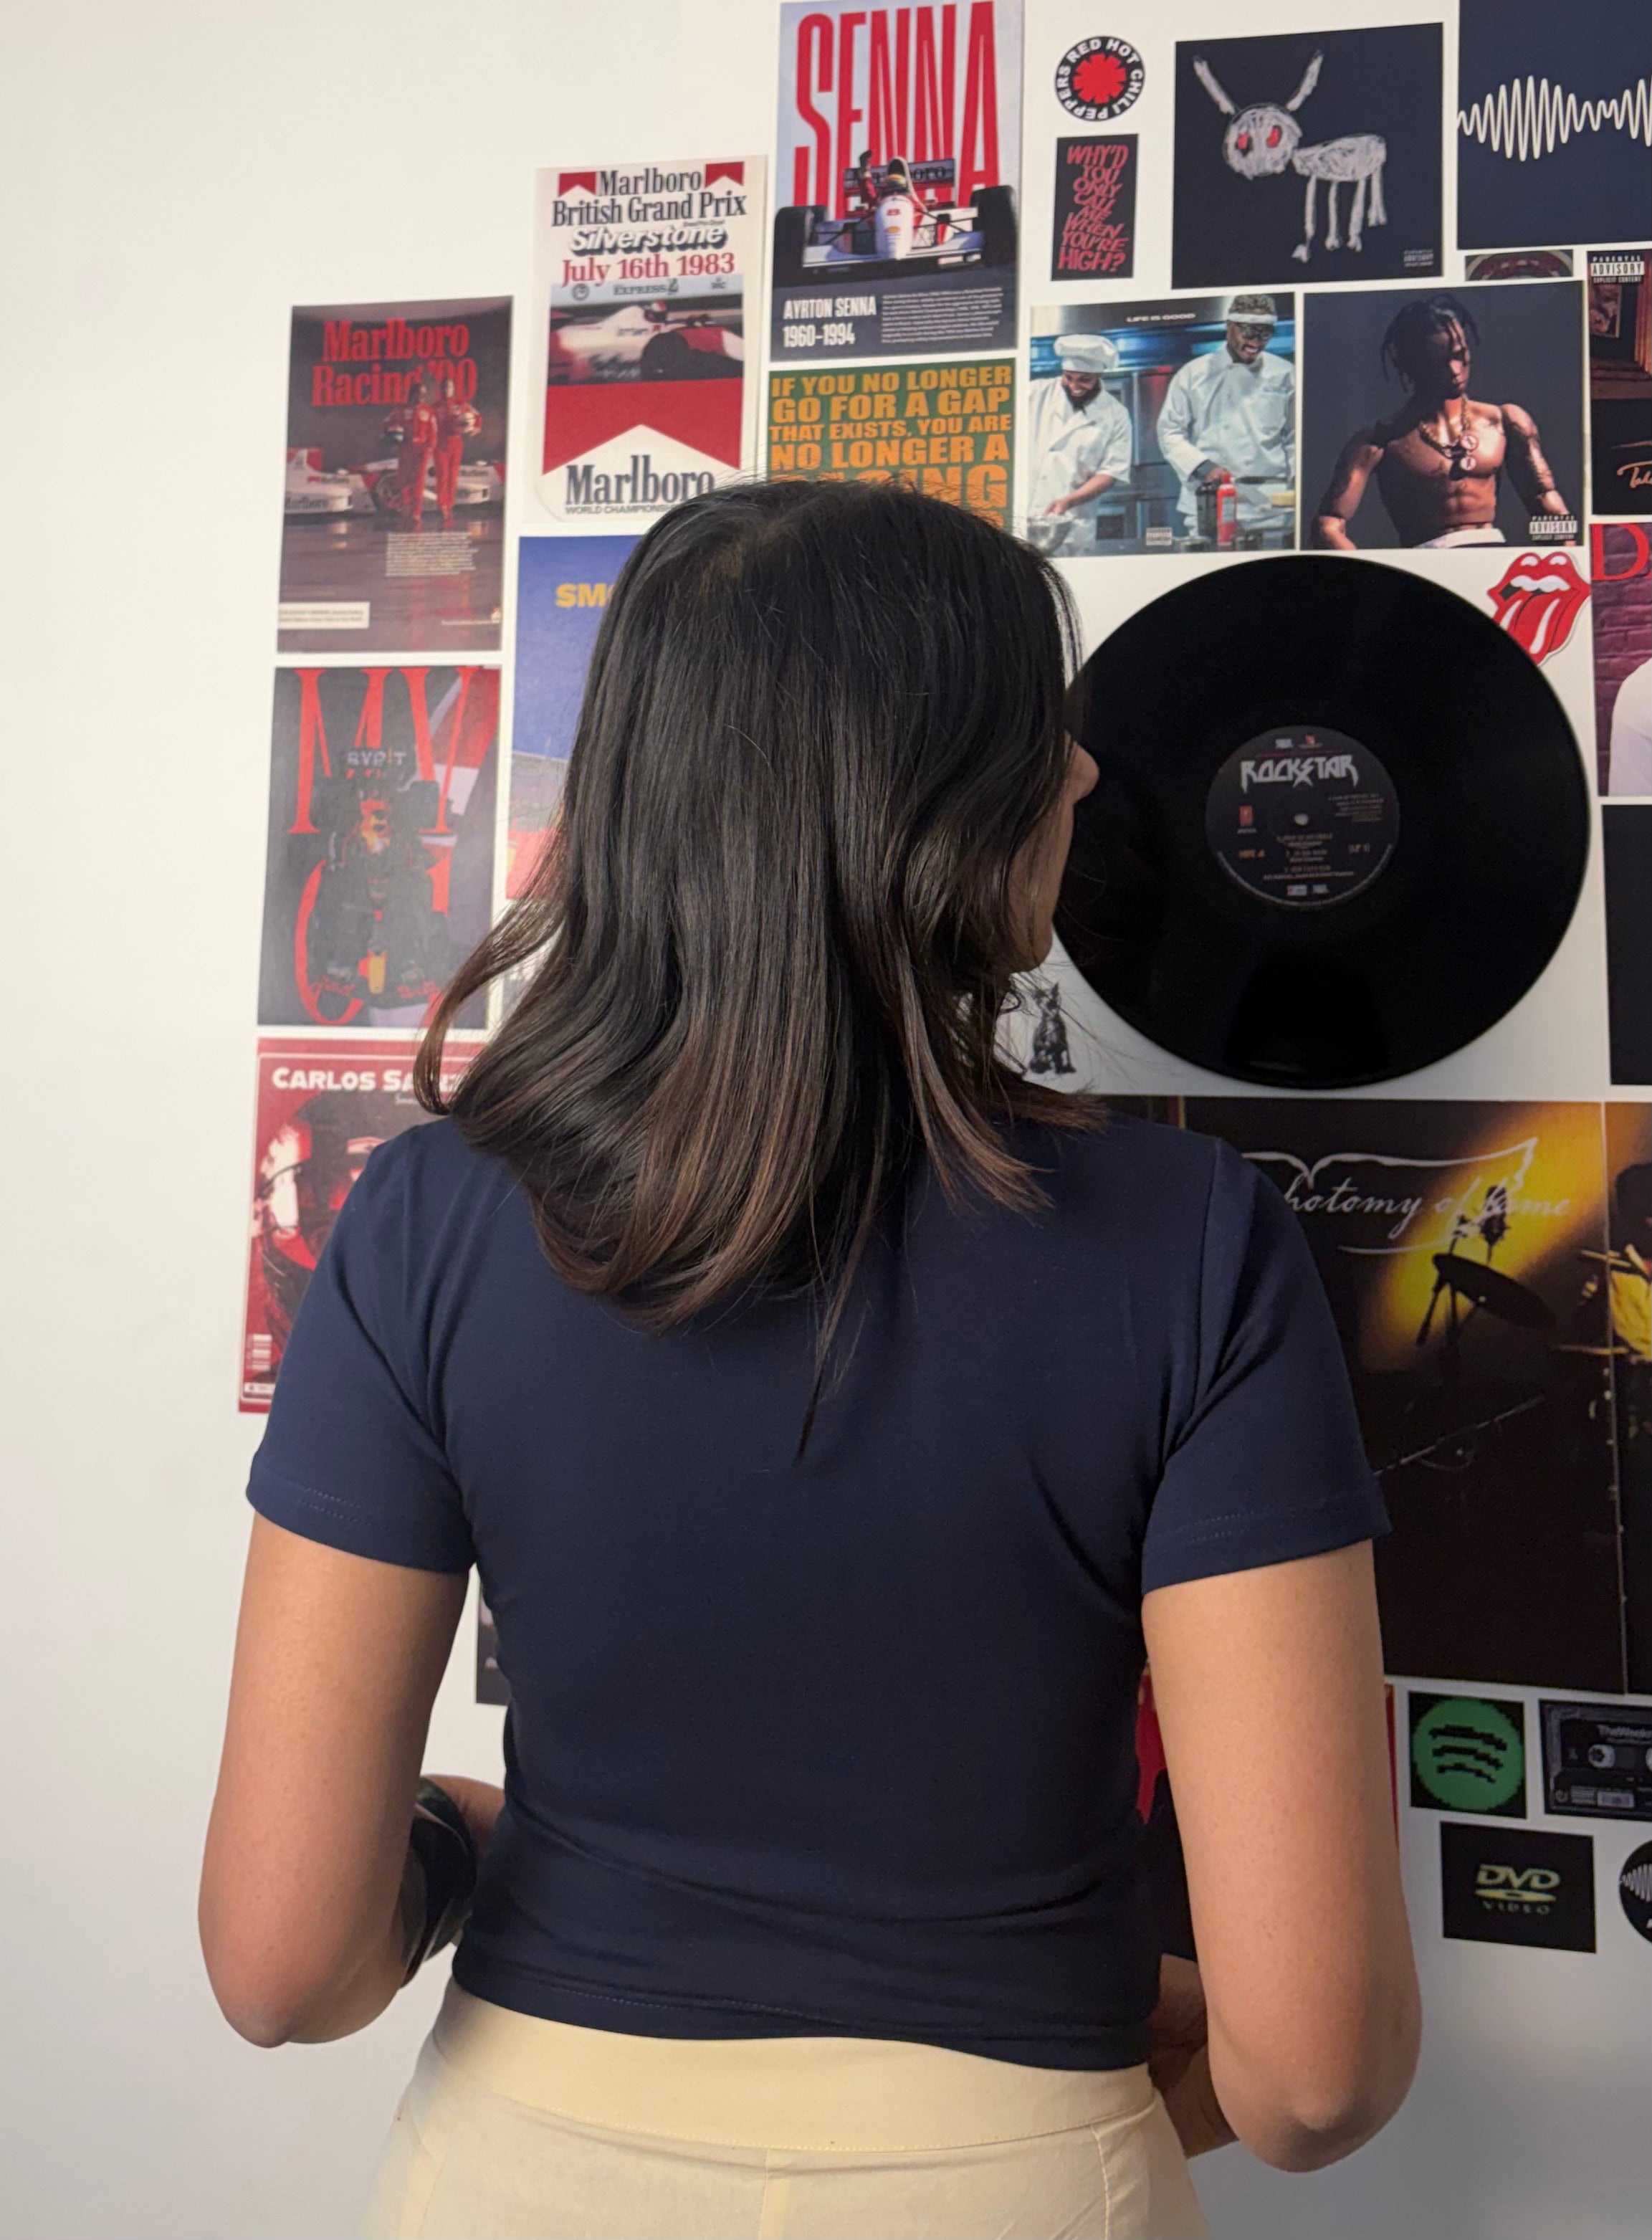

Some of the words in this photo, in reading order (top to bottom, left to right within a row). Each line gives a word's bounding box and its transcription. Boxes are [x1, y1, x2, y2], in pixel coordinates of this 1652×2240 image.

[1066, 38, 1102, 67] RED
[1105, 38, 1138, 65] HOT
[1056, 65, 1109, 120] PEPPERS
[1112, 69, 1144, 115] CHILI
[793, 1, 999, 220] SENNA
[1066, 145, 1129, 169] WHY'D
[599, 168, 702, 196] Marlboro
[1073, 177, 1123, 197] ONLY
[1084, 165, 1120, 184] YOU
[552, 199, 623, 227] British
[628, 193, 692, 222] Grand
[700, 190, 747, 218] Prix
[1074, 192, 1116, 210] CALL
[1065, 212, 1125, 238] WHEN
[571, 225, 728, 257] Silverstone
[1062, 230, 1129, 252] YOU'RE
[563, 257, 610, 287] July
[617, 254, 669, 280] 16th
[677, 252, 735, 276] 1983
[1058, 247, 1126, 272] HIGH?
[1593, 263, 1641, 275] ADVISORY
[783, 297, 832, 320] AYRTON
[835, 296, 877, 317] SENNA
[323, 318, 469, 362] Marlboro
[772, 378, 796, 397] IF
[801, 374, 855, 396] YOU
[862, 371, 900, 394] NO
[907, 366, 1012, 391] LONGER
[773, 396, 821, 423] GO
[830, 394, 897, 421] FOR
[904, 391, 929, 418] A
[937, 387, 1010, 416] GAP
[770, 424, 824, 442] THAT
[830, 420, 912, 440] EXISTS,
[917, 417, 963, 436] YOU
[968, 414, 1011, 433] ARE
[770, 443, 822, 472] NO
[832, 436, 975, 469] LONGER
[984, 434, 1010, 462] A
[565, 454, 715, 505] Marlboro
[566, 505, 603, 515] WORLD
[1241, 755, 1360, 793] ROCKSTAR
[272, 1067, 376, 1092] CARLOS
[1476, 1864, 1561, 1889] DVD
[1482, 1901, 1552, 1915] VIDEO
